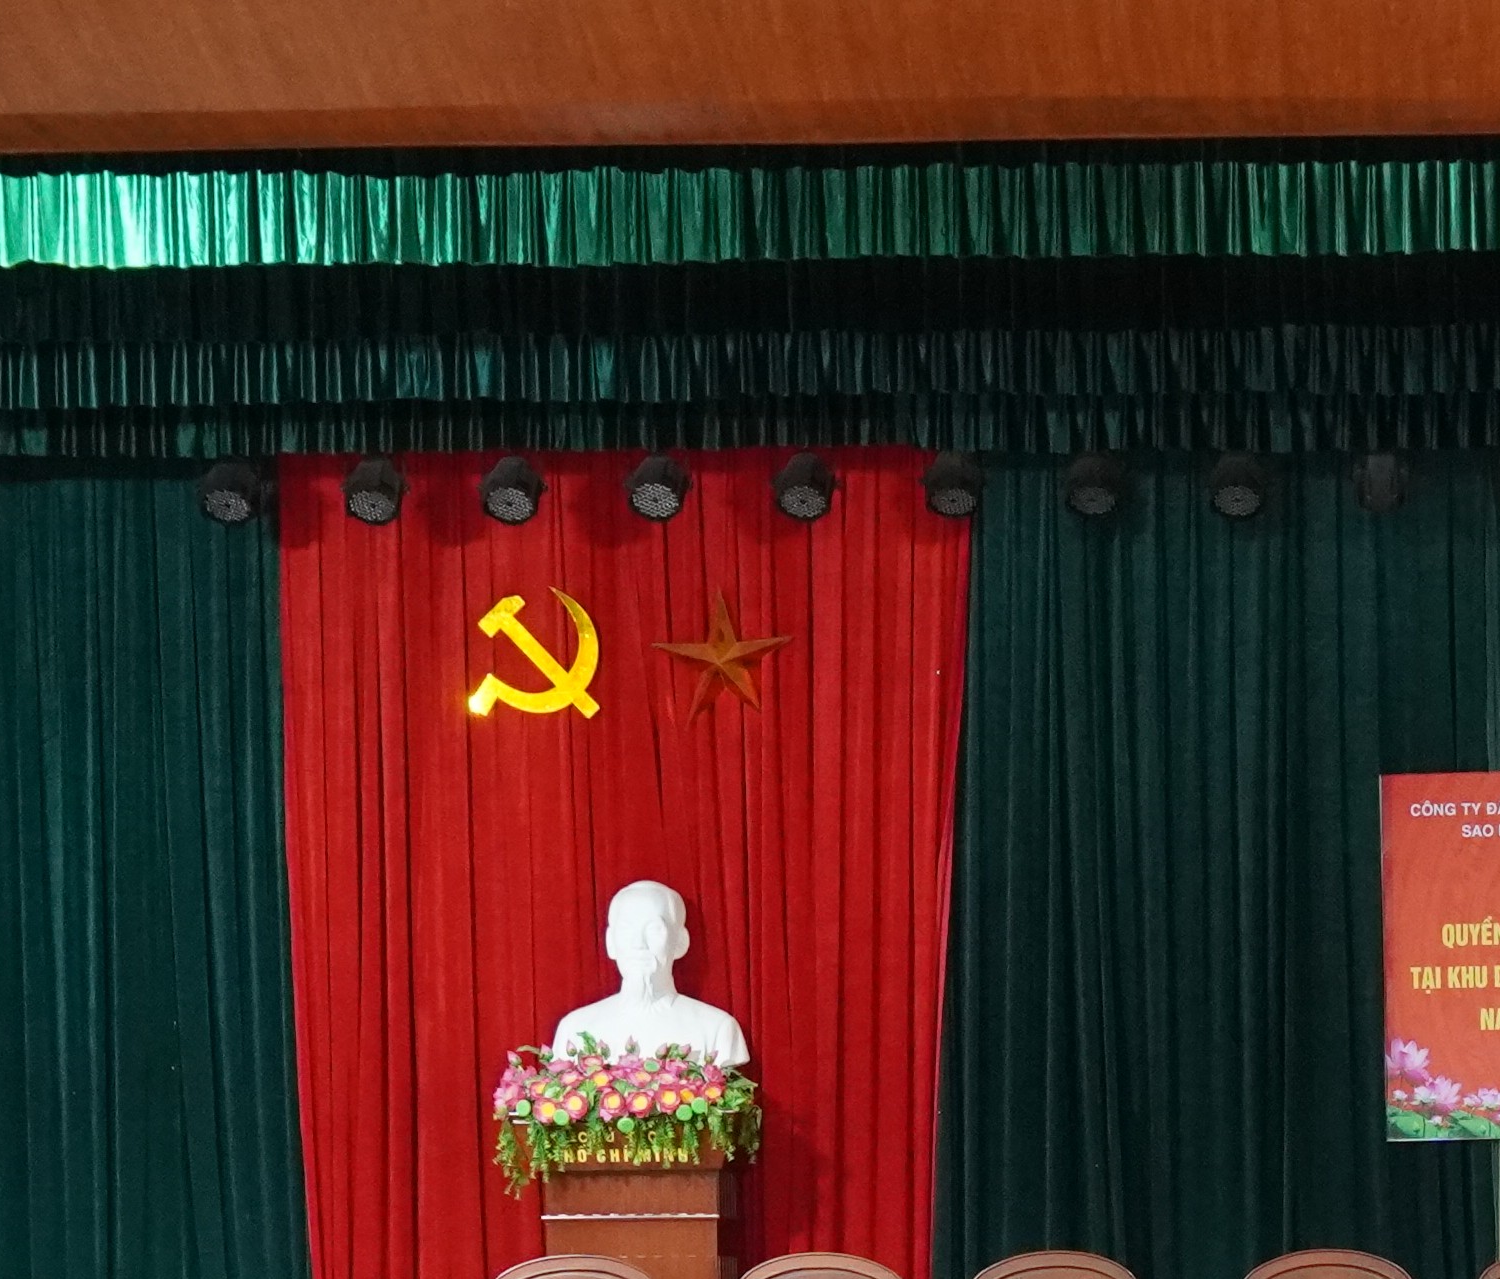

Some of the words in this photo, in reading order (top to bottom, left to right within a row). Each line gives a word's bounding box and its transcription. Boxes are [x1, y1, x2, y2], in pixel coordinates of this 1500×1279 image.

[1410, 798, 1456, 817] CÔNG
[1461, 800, 1481, 815] TY
[1461, 822, 1494, 838] SAO
[1410, 965, 1442, 993] TẠI
[1447, 965, 1488, 990] KHU
